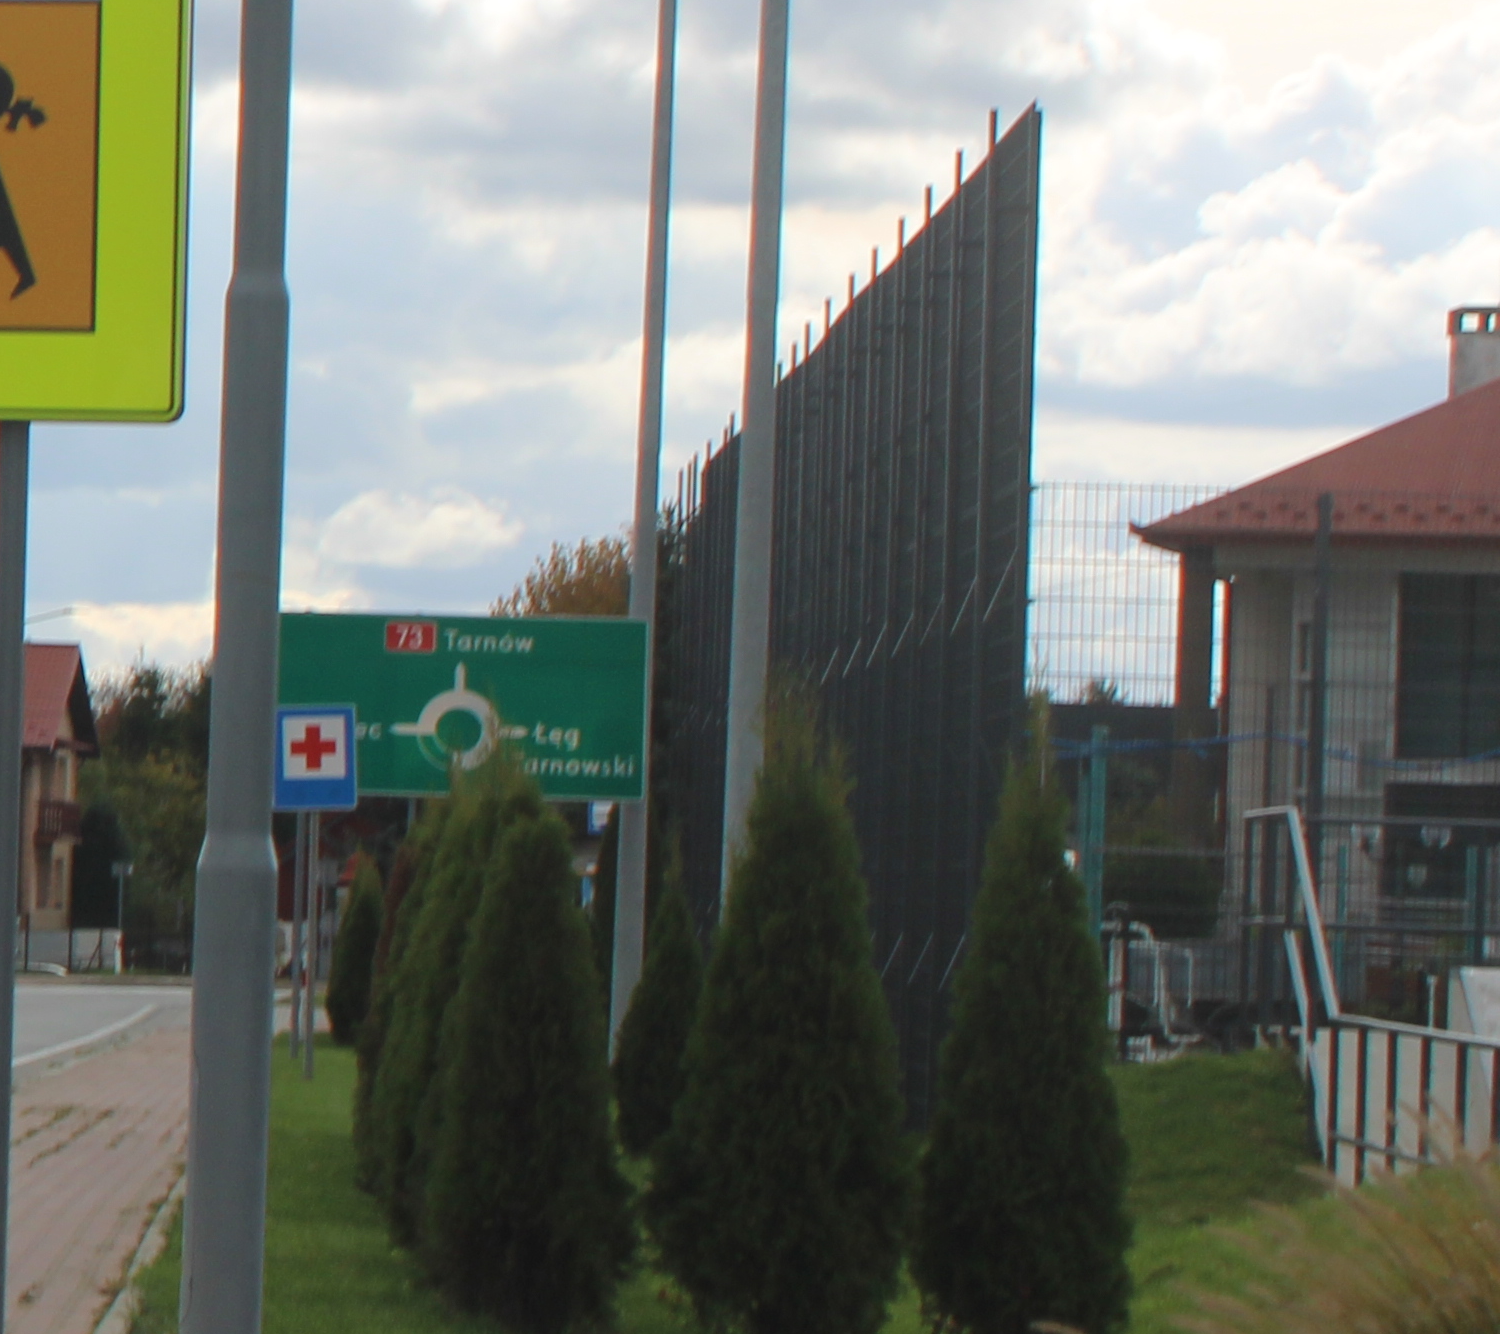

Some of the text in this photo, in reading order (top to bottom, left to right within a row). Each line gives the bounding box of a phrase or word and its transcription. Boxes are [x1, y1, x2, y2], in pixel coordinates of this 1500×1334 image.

[395, 624, 534, 653] 73 Tarnów
[533, 723, 580, 751] Łęg
